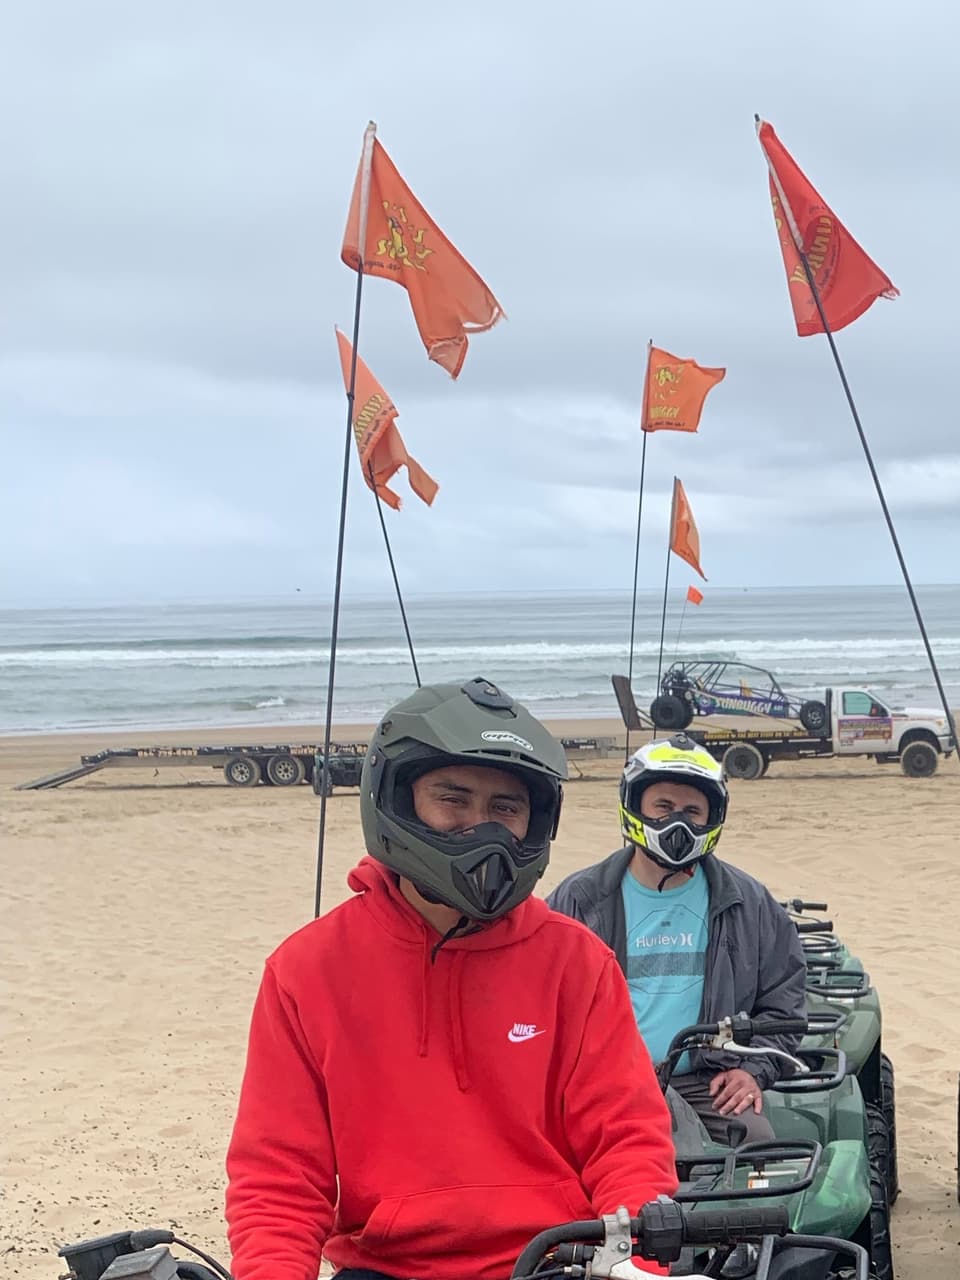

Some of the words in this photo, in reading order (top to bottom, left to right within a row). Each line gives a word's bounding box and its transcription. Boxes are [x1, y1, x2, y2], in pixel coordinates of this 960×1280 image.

[715, 696, 773, 714] SUNBUGGY
[636, 933, 679, 949] Hurley
[512, 1022, 537, 1036] NIKE
